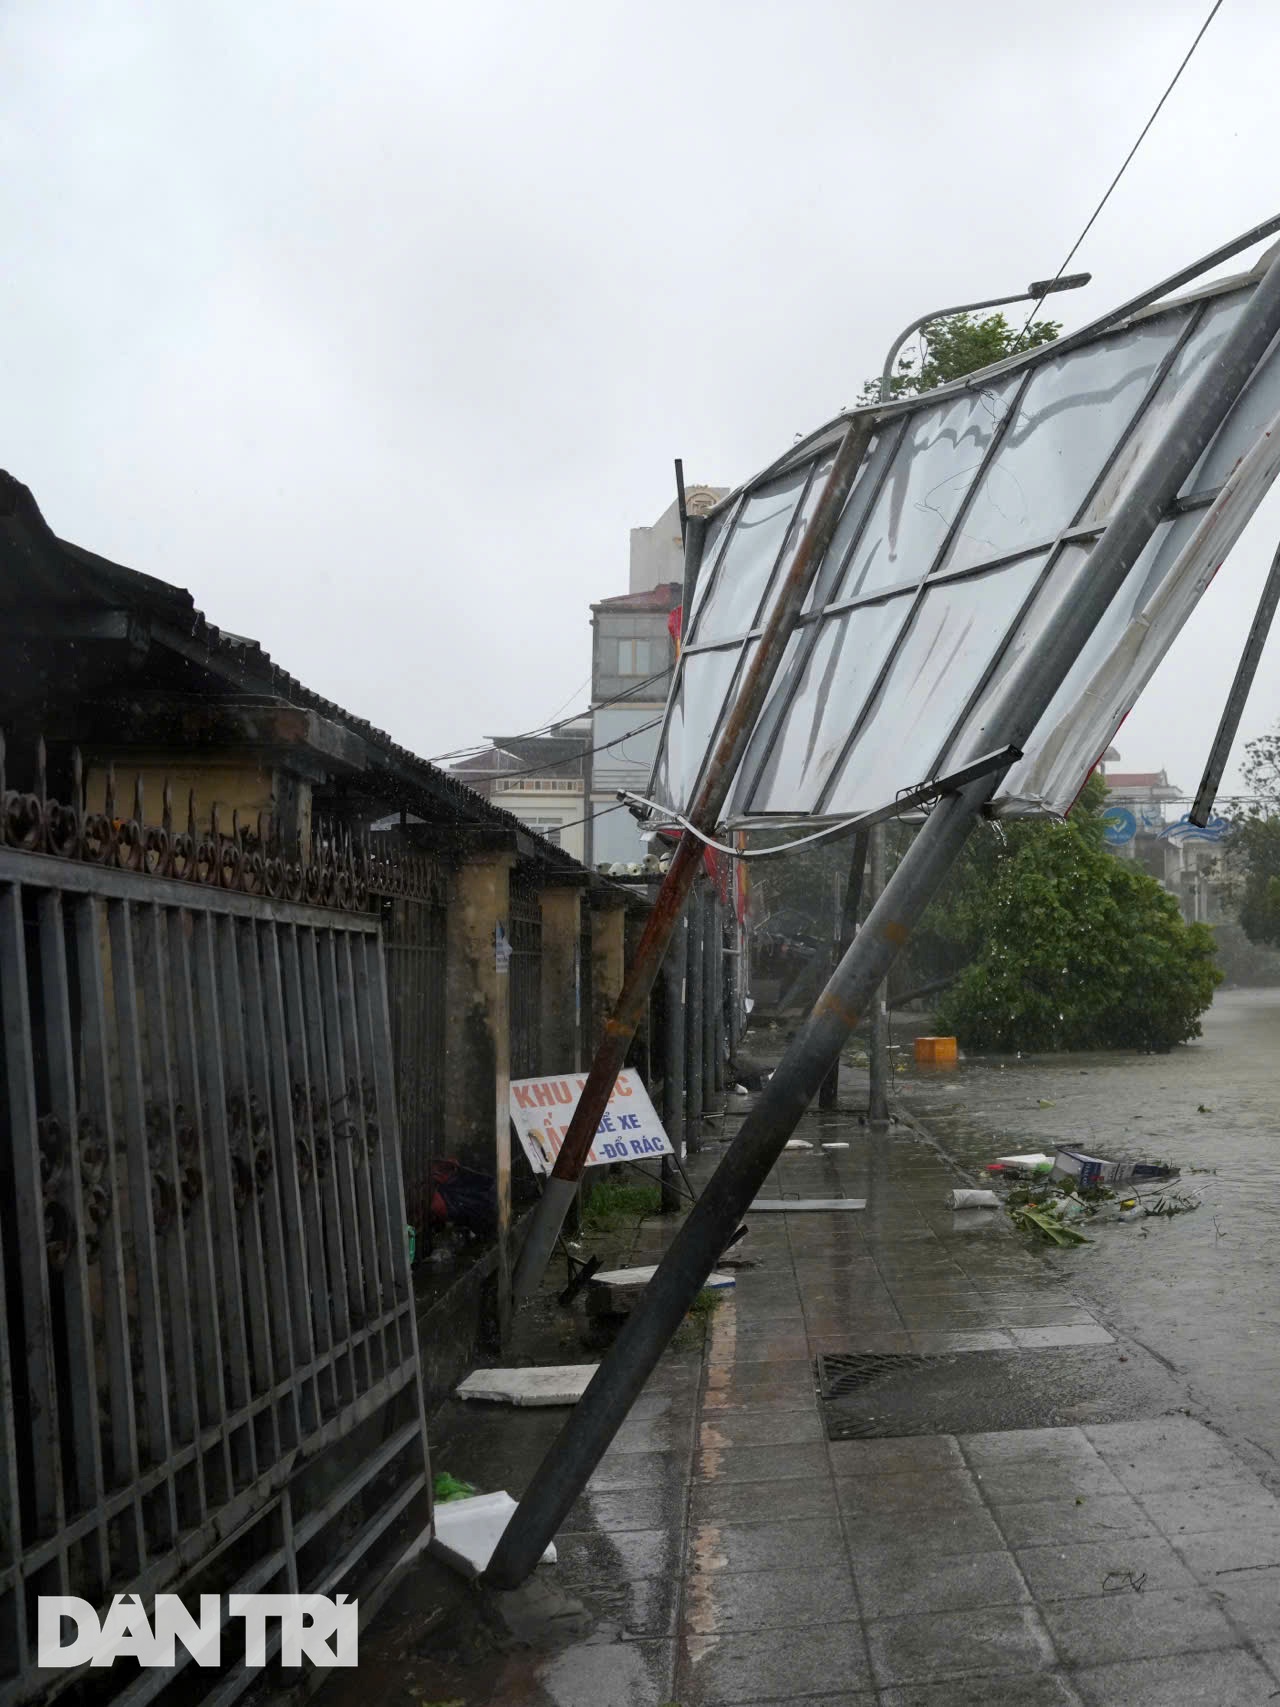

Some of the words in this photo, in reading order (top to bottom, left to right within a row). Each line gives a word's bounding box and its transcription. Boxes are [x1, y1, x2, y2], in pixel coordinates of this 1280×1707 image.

[512, 1080, 573, 1109] KHU
[617, 1114, 641, 1130] XE
[630, 1136, 665, 1155] RÁC
